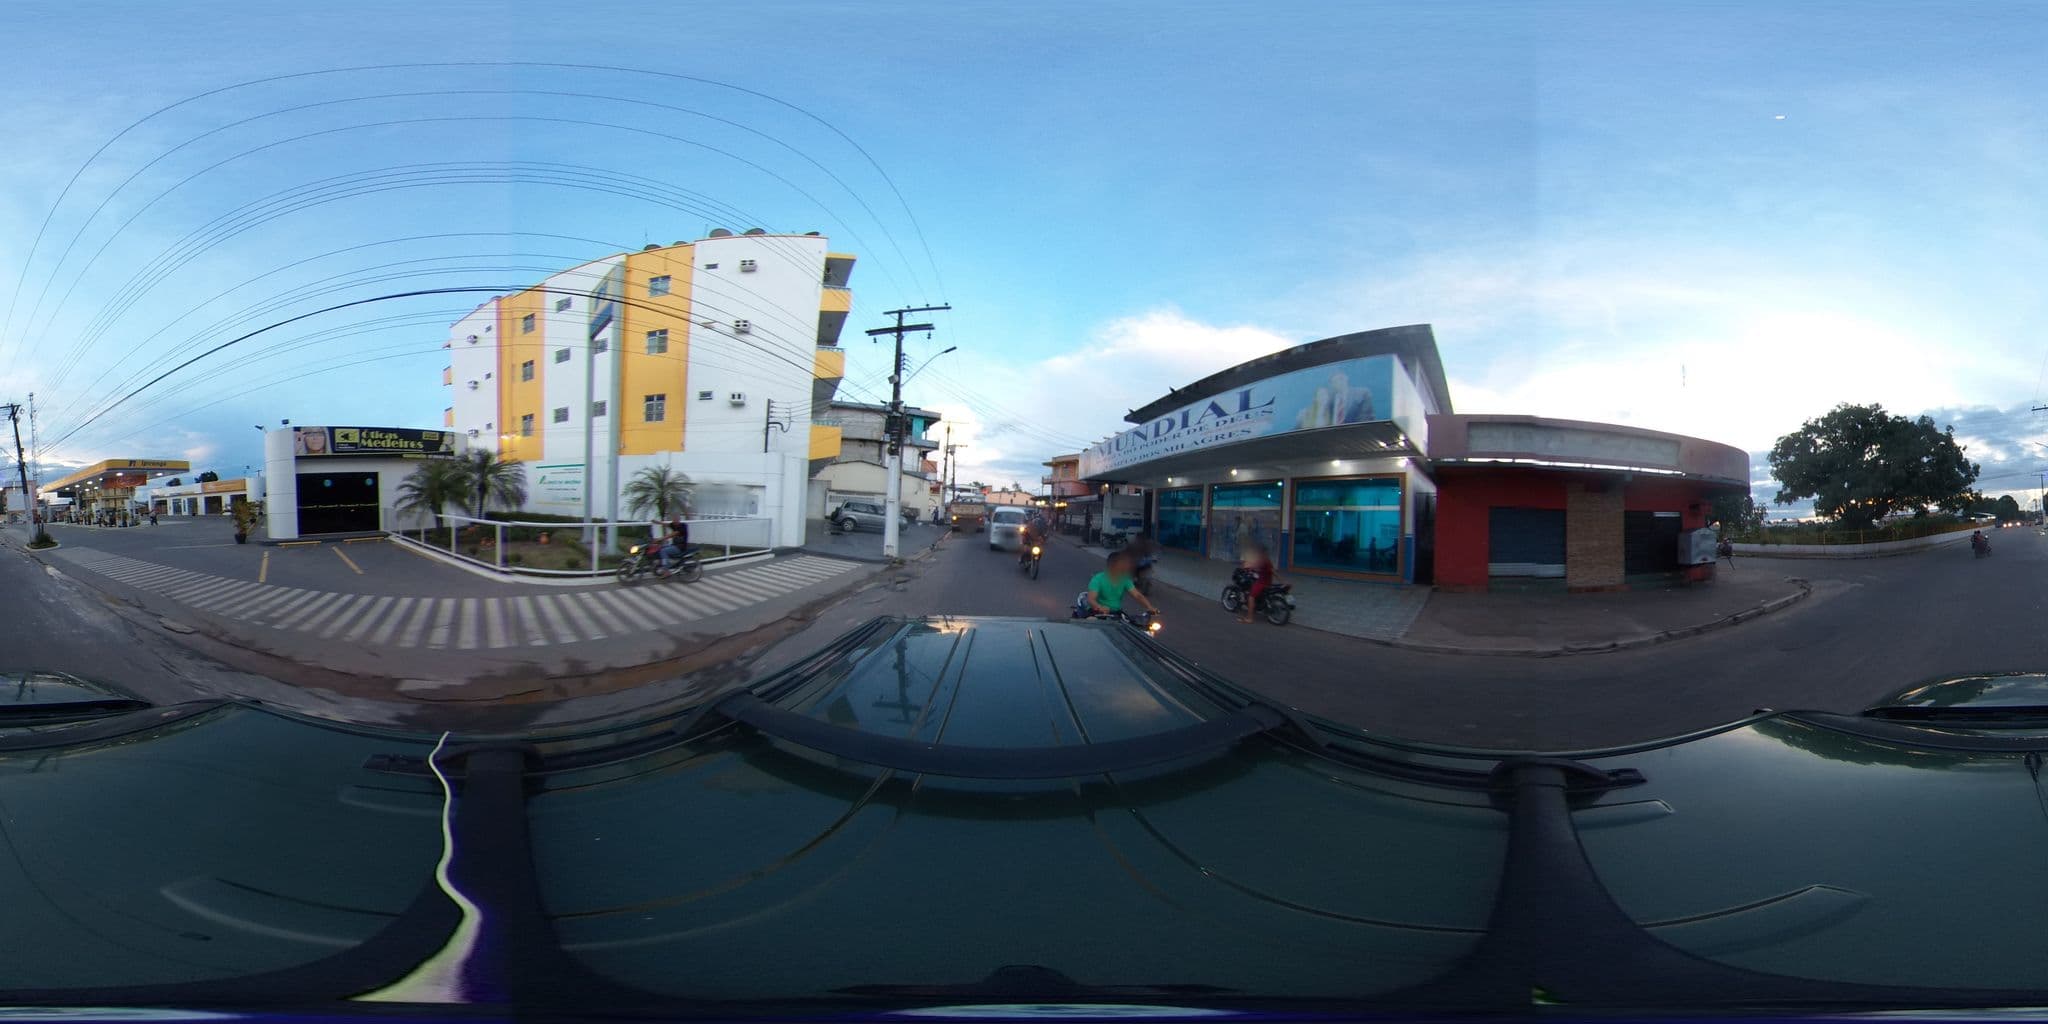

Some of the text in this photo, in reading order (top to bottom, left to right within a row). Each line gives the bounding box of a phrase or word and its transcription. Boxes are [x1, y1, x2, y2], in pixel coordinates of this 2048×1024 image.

[1098, 387, 1276, 457] MUNDIAL
[1140, 431, 1181, 449] PODER
[1186, 423, 1208, 436] DE
[1215, 409, 1273, 427] DEUS
[361, 438, 425, 449] Medeiros
